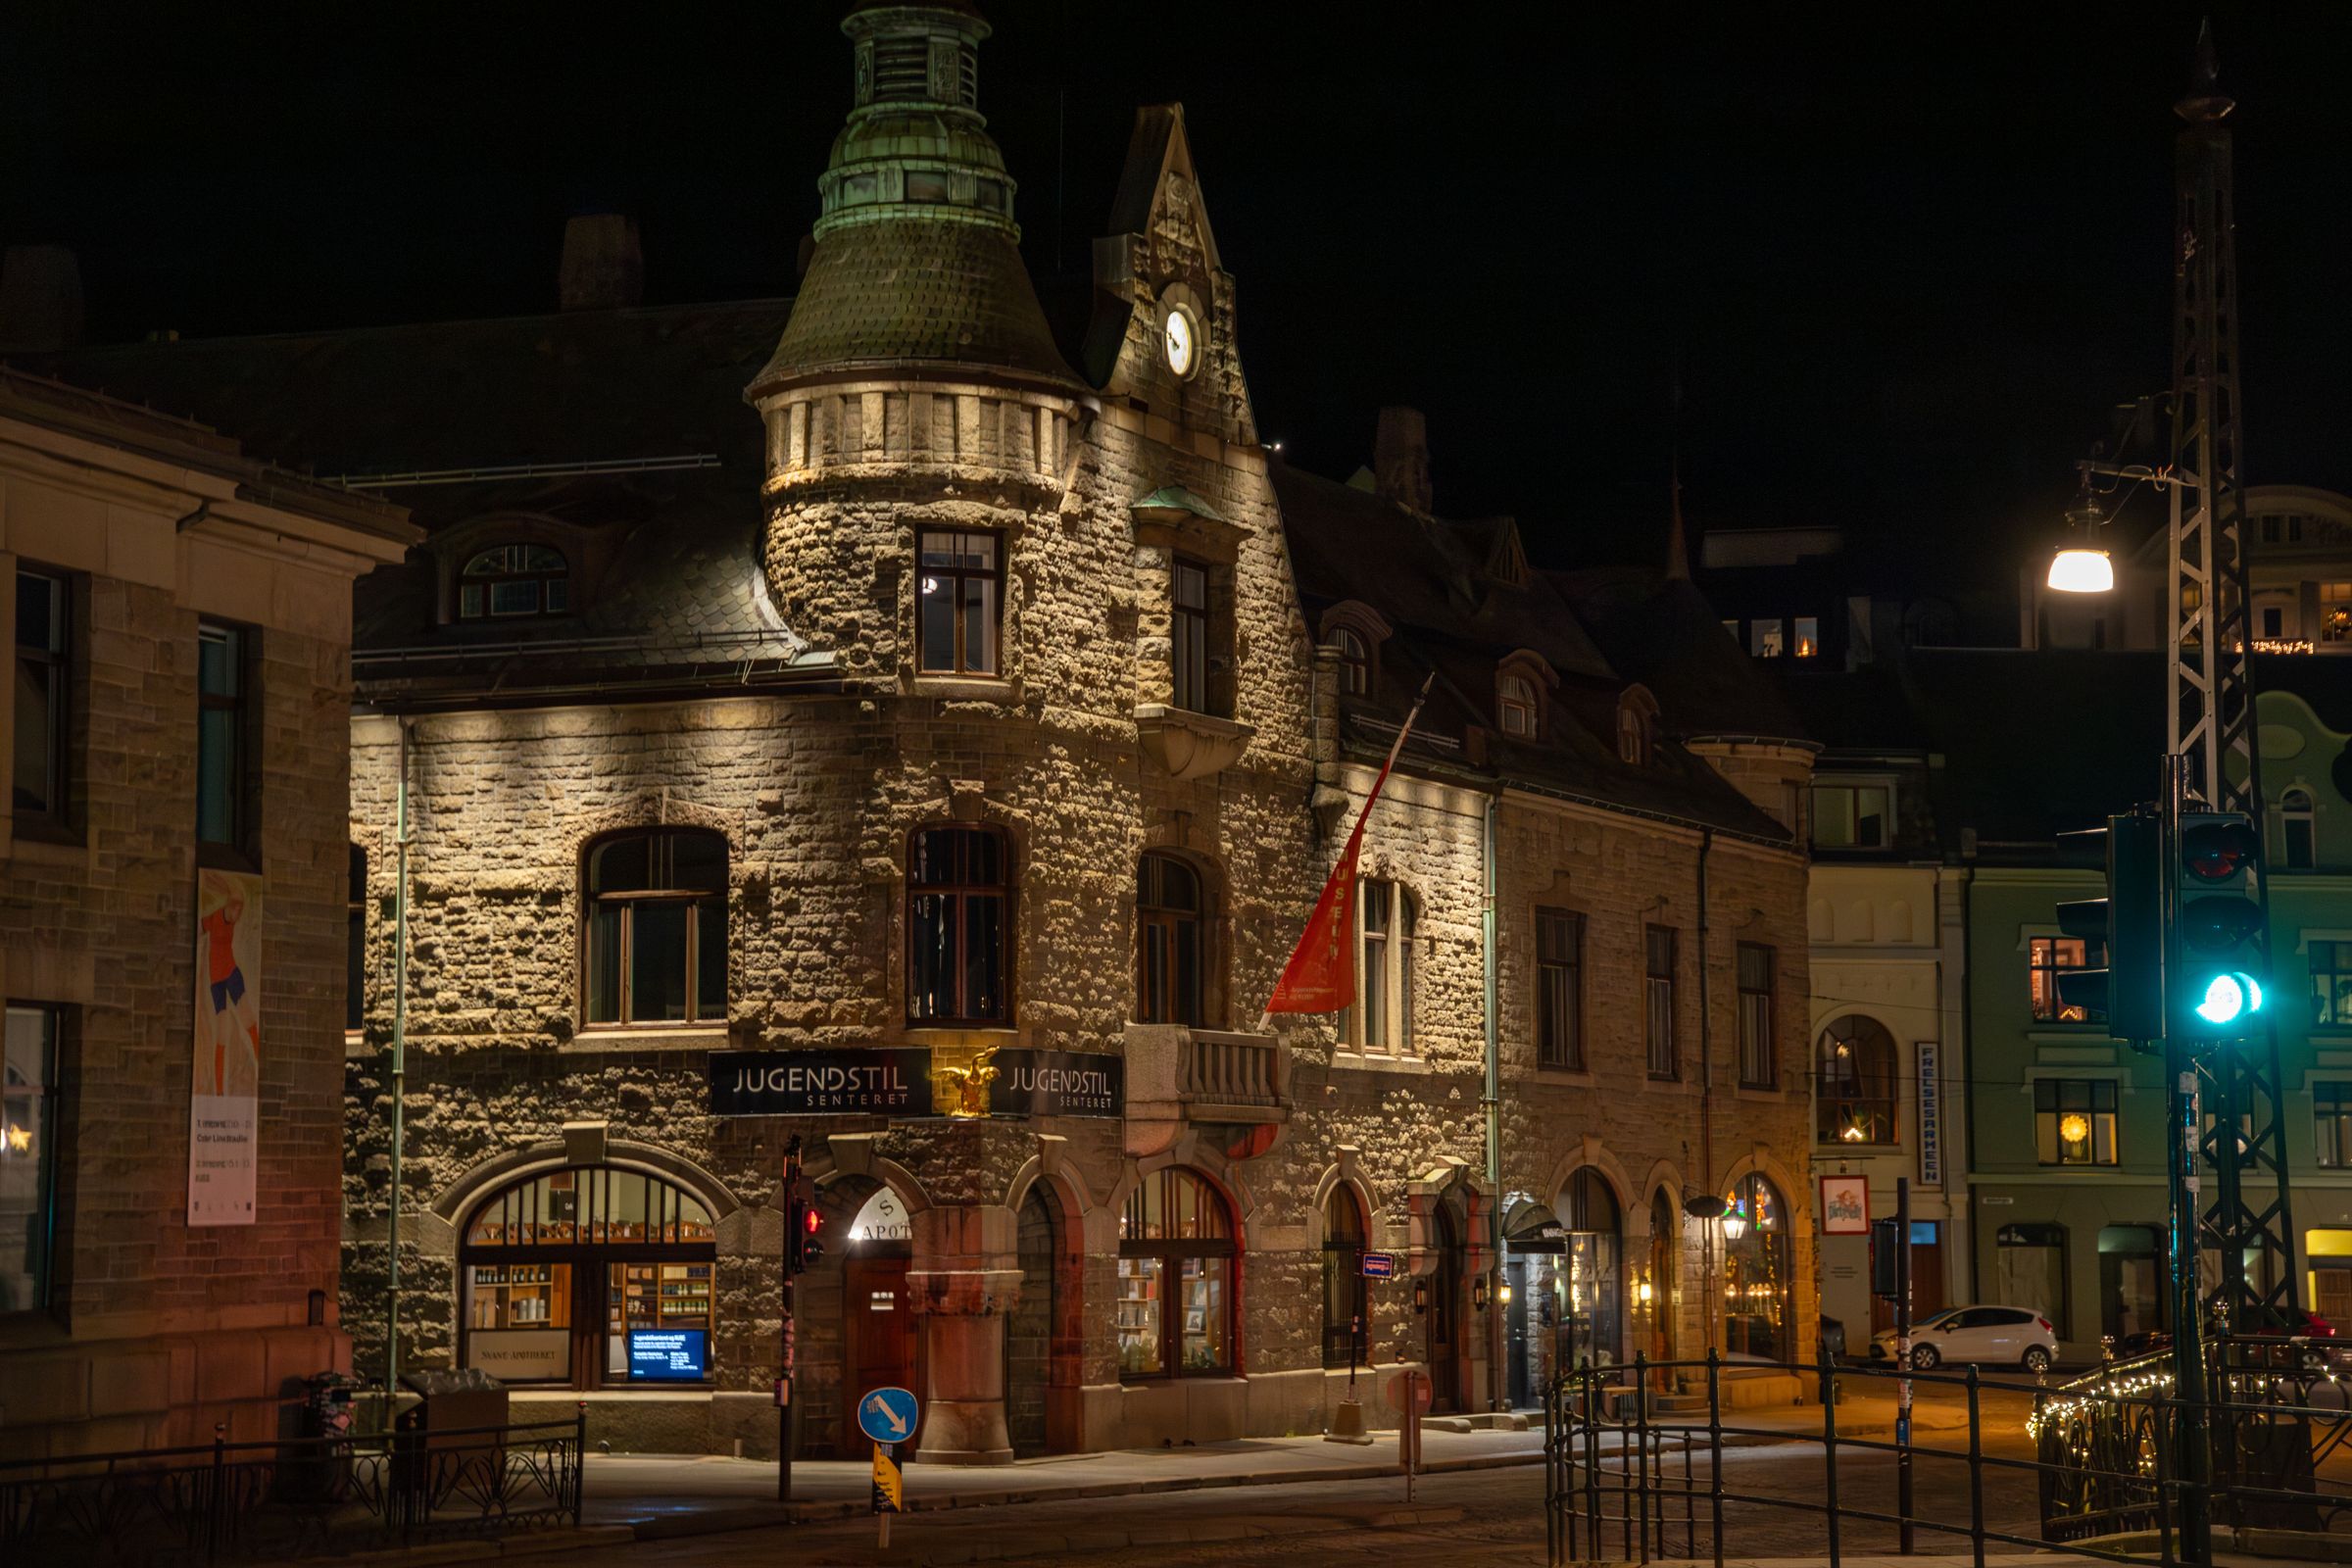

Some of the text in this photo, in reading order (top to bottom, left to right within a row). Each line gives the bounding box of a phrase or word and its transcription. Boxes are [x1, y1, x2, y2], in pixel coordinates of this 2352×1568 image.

[732, 1066, 907, 1093] JUGENDSTIL
[1008, 1066, 1111, 1096] JUGENDSTIL
[807, 1094, 908, 1105] SENTERET
[1059, 1096, 1111, 1108] SENTERET
[1922, 1047, 1937, 1181] FRELSESARMEEN
